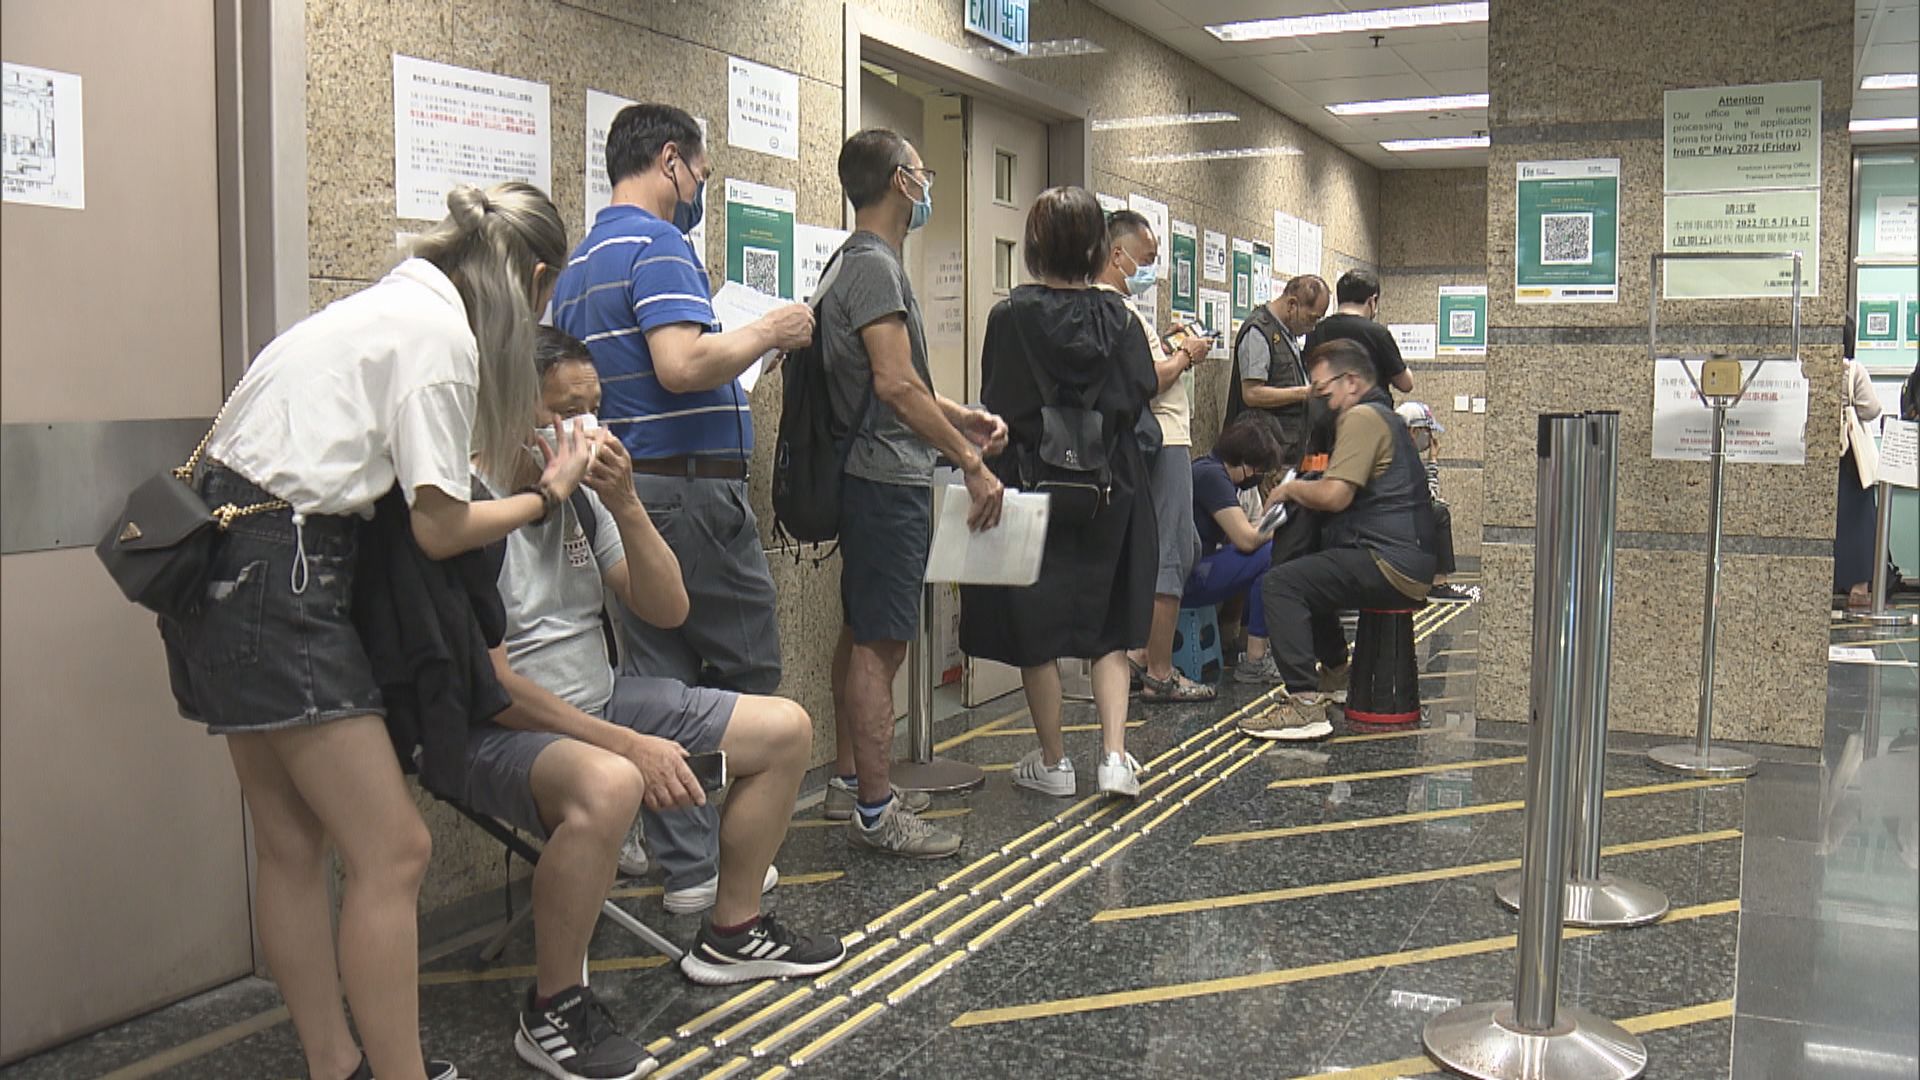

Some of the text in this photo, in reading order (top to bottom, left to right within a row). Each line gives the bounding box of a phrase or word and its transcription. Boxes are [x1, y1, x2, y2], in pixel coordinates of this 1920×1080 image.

[1718, 95, 1764, 107] Attention
[1673, 105, 1811, 120] Our office will resume
[1673, 117, 1811, 134] processing the application
[1673, 135, 1698, 144] forms
[1700, 134, 1712, 142] for
[1714, 132, 1747, 142] Driving
[1750, 130, 1773, 139] Tests
[1673, 147, 1696, 158] from
[1713, 144, 1733, 155] May
[1736, 144, 1759, 154] 2022
[1762, 140, 1801, 152] (Friday)
[1725, 203, 1756, 215] 請注意
